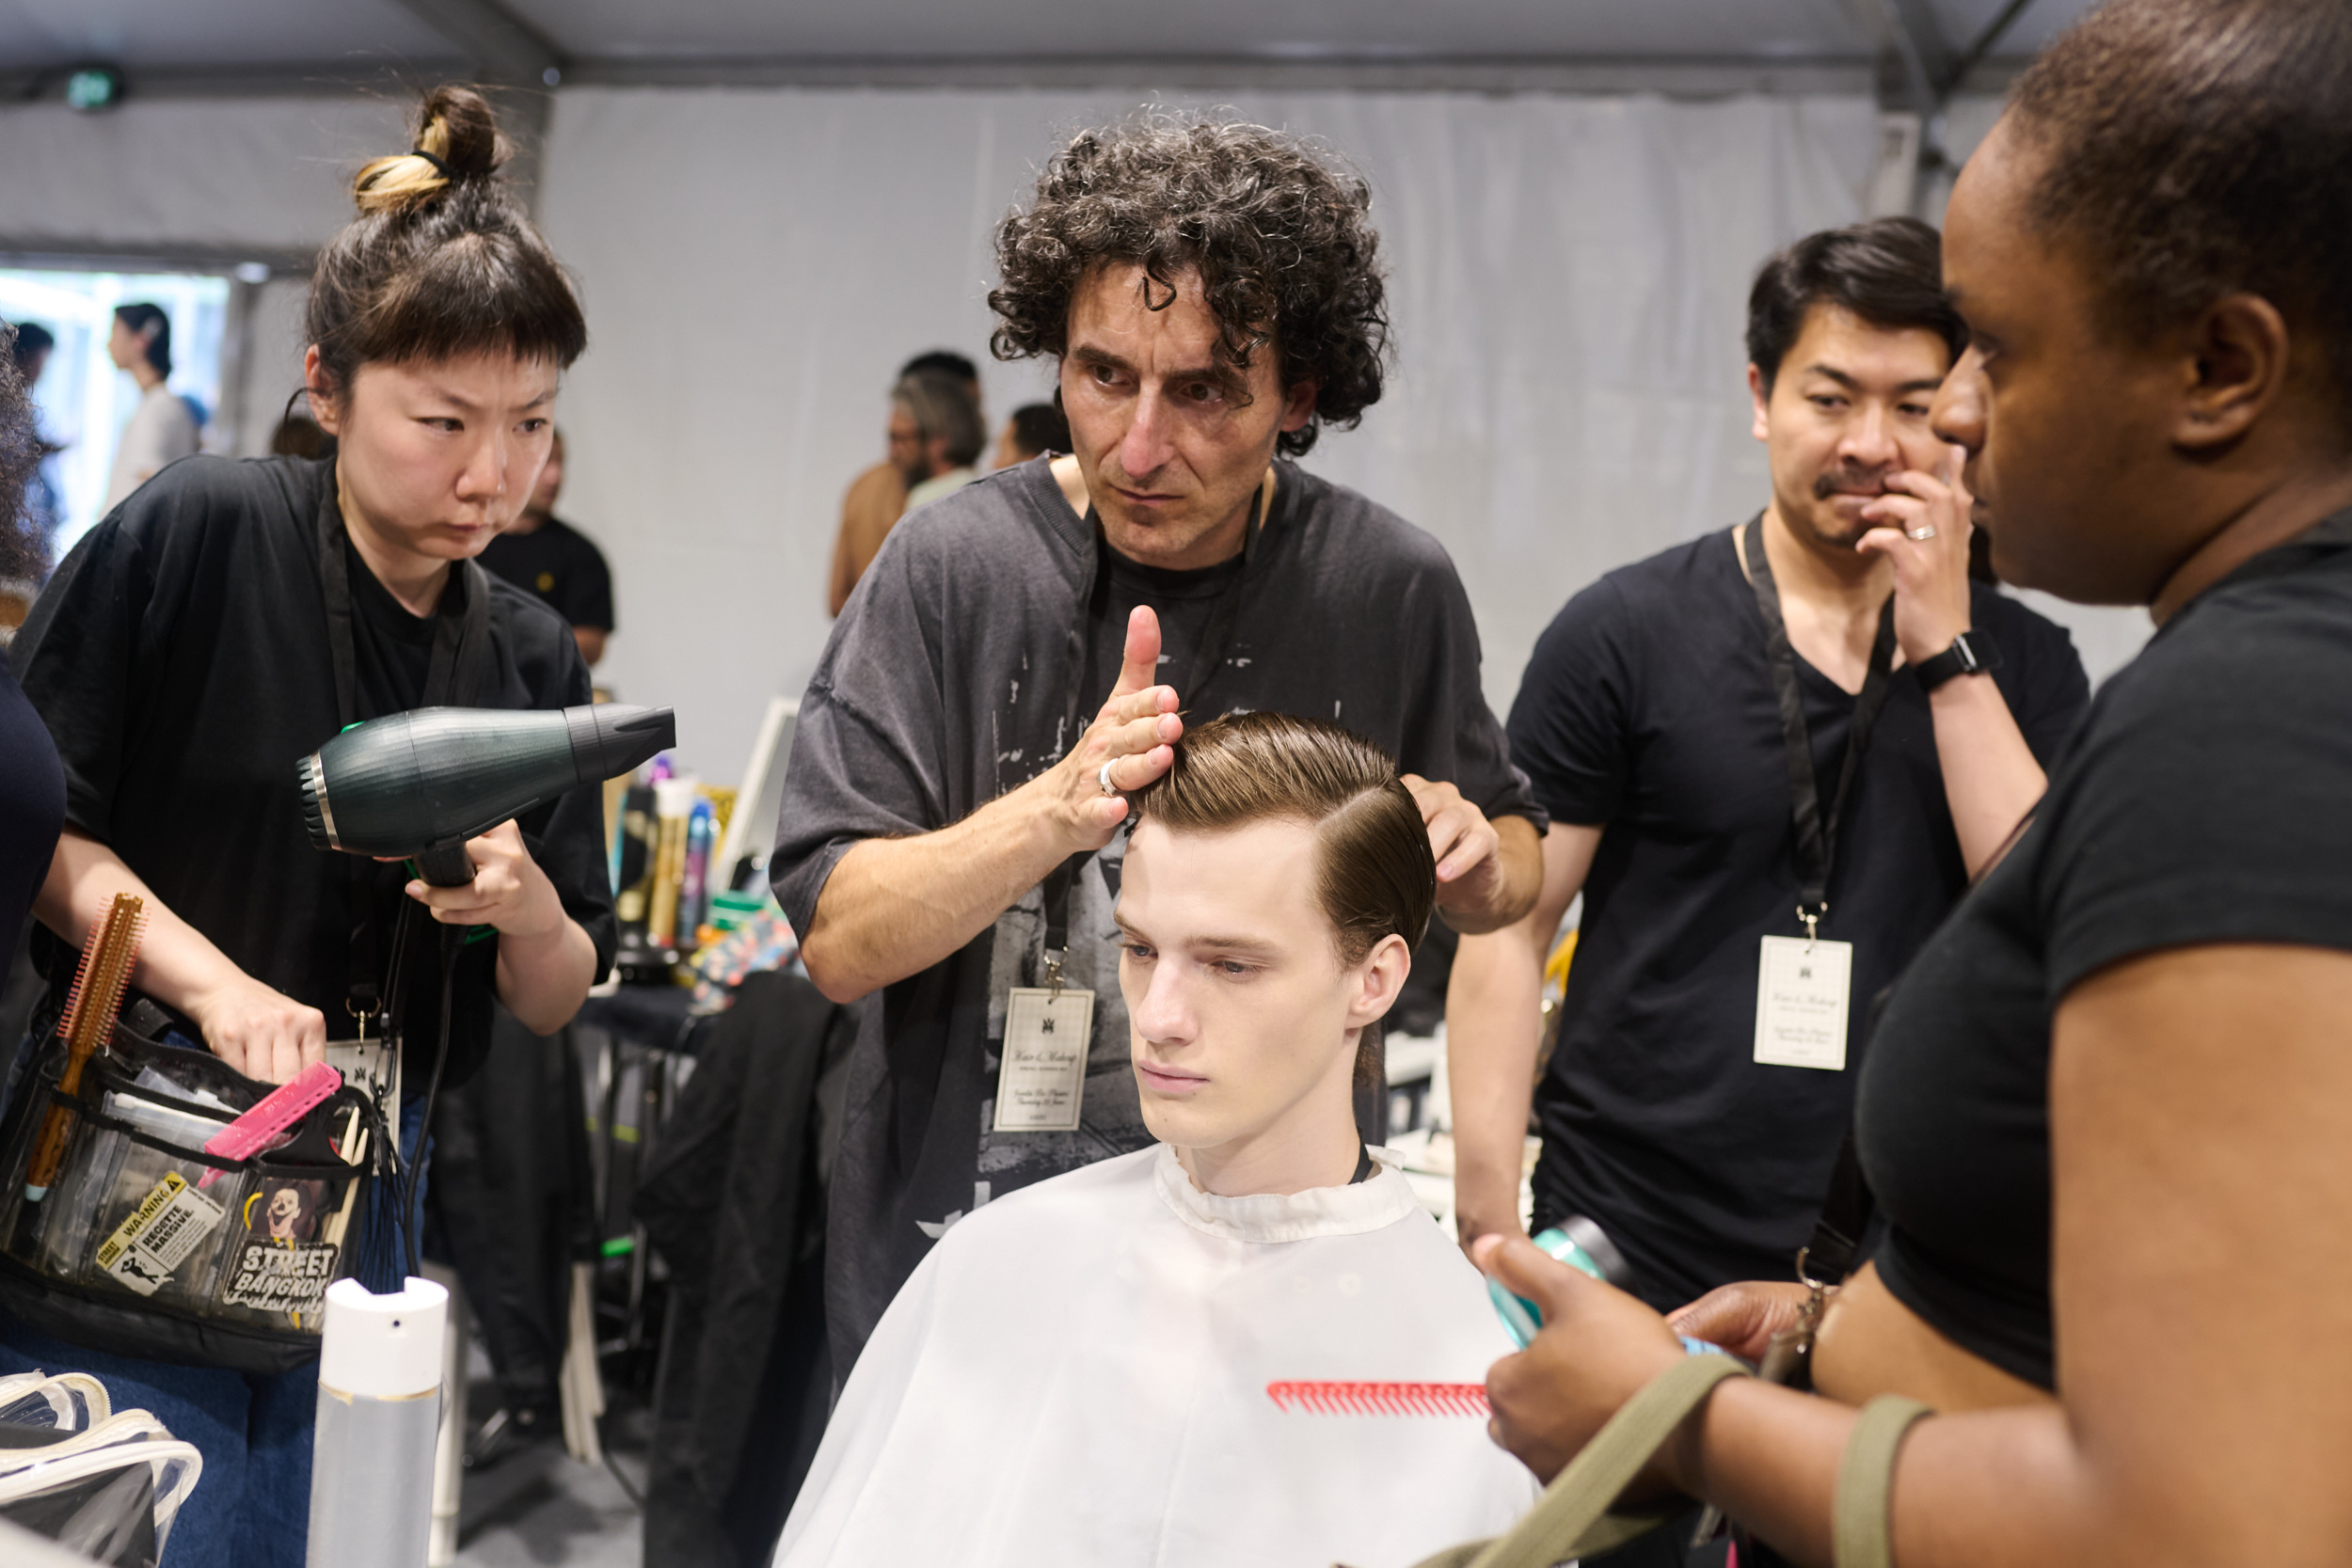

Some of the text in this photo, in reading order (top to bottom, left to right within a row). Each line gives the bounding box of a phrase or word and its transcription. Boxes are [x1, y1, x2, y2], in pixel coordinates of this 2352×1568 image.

[123, 1189, 169, 1237] WARNING
[142, 1205, 183, 1247] RECETTE
[151, 1211, 195, 1253] MASSIVE.
[243, 1245, 334, 1276] STREET
[234, 1272, 327, 1297] BANGKOK
